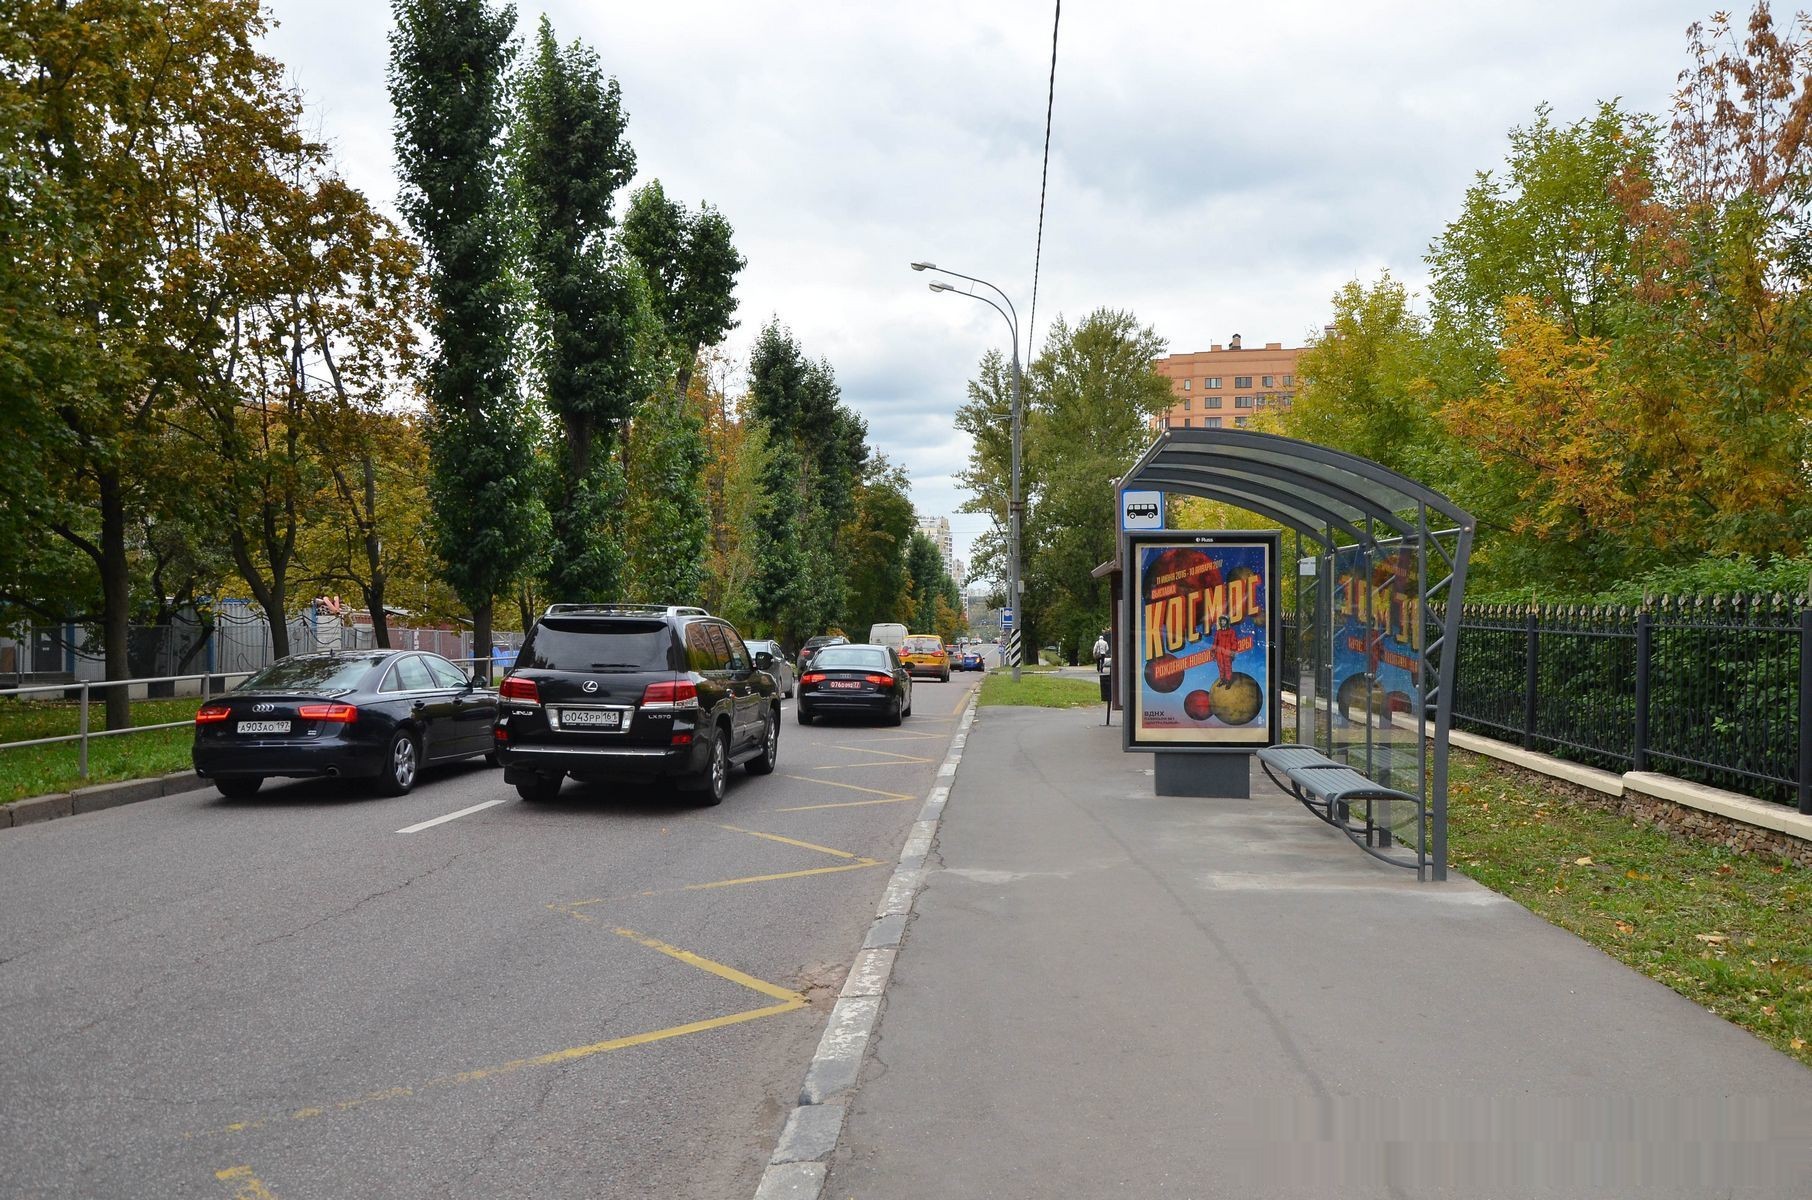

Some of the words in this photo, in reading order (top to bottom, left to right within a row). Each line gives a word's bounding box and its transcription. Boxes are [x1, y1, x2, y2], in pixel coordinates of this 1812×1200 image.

[1145, 574, 1260, 660] КОСМОС
[1155, 657, 1188, 677] РОЖДЕНИЕ
[1237, 637, 1252, 651] ЭРЫ
[276, 722, 289, 730] 197
[602, 712, 618, 721] 161
